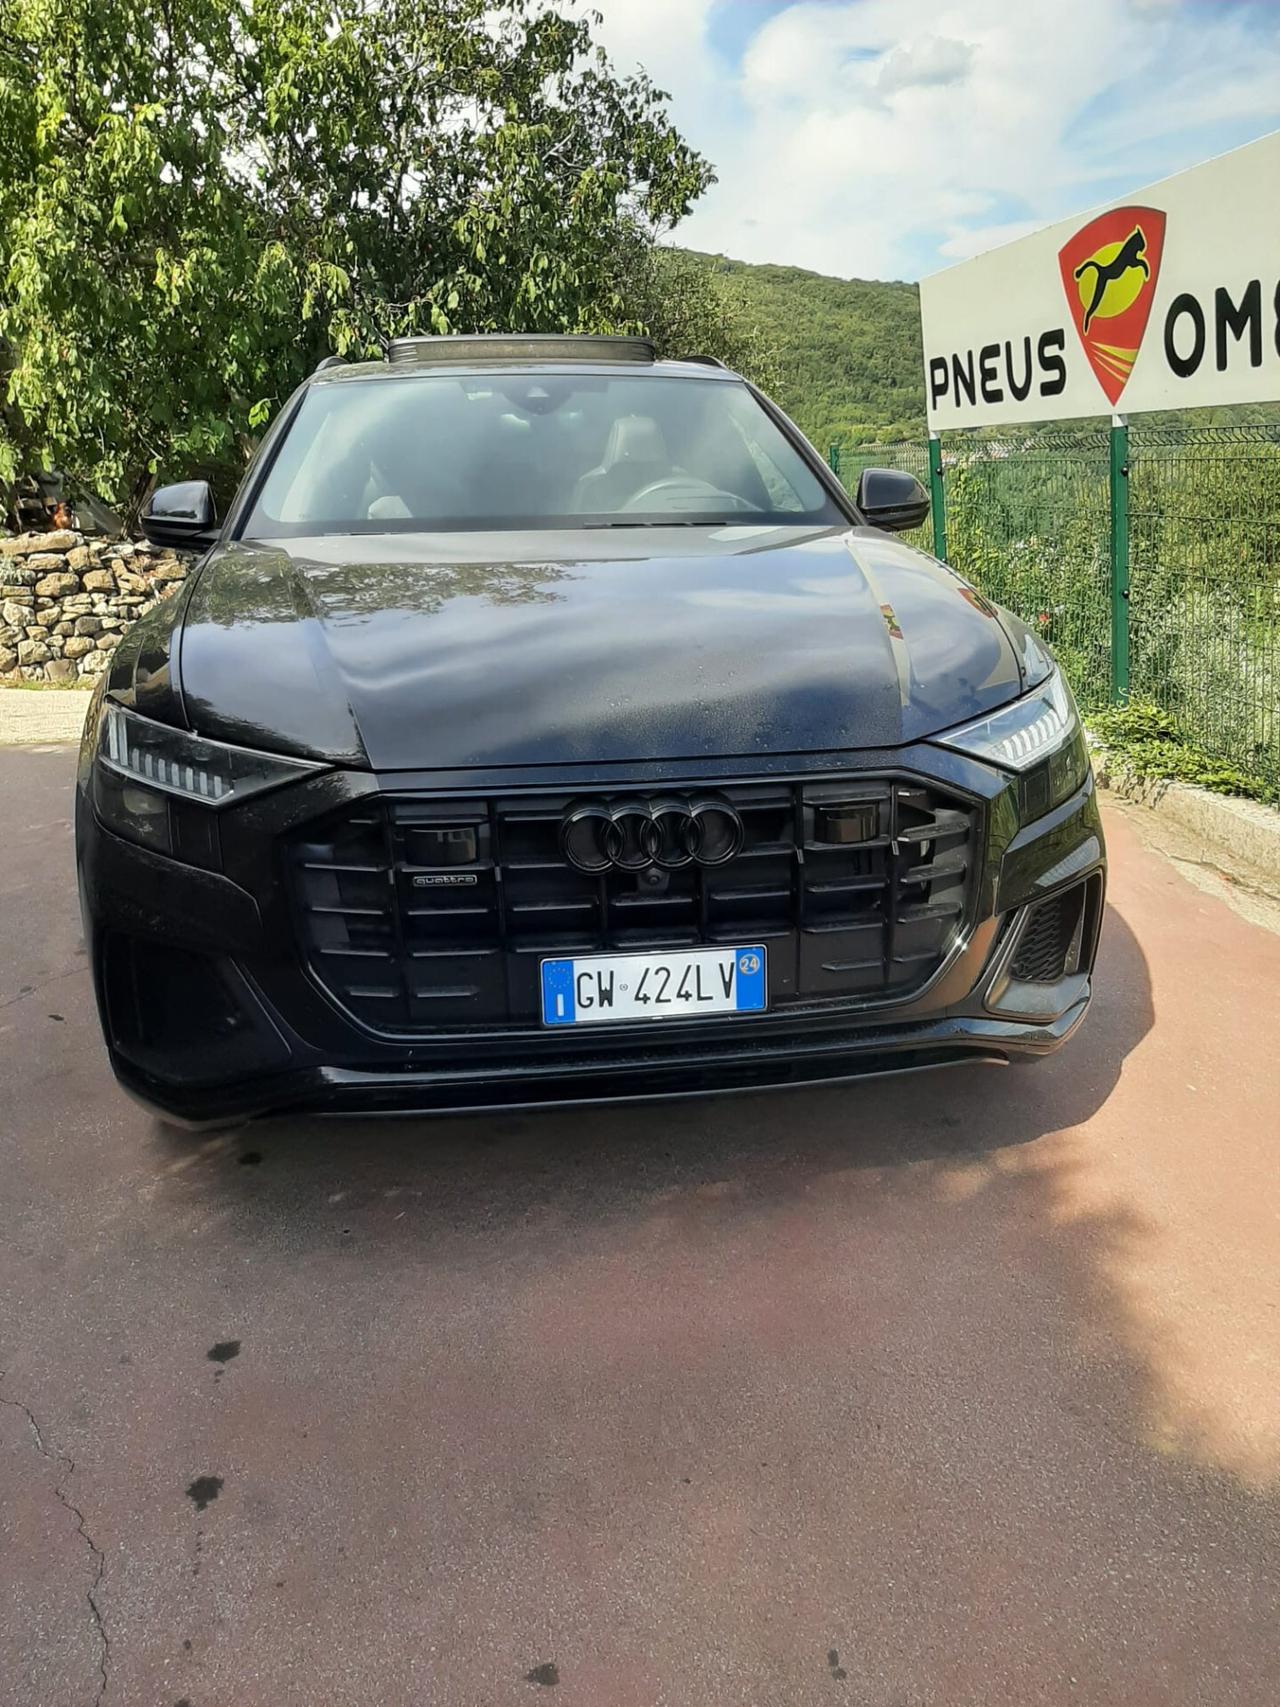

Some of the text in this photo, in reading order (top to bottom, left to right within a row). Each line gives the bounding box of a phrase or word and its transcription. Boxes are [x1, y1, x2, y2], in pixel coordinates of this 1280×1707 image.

[929, 327, 1067, 411] PNEUS
[576, 970, 614, 1009] GW
[633, 962, 735, 1005] 424LV
[740, 958, 757, 970] 24
